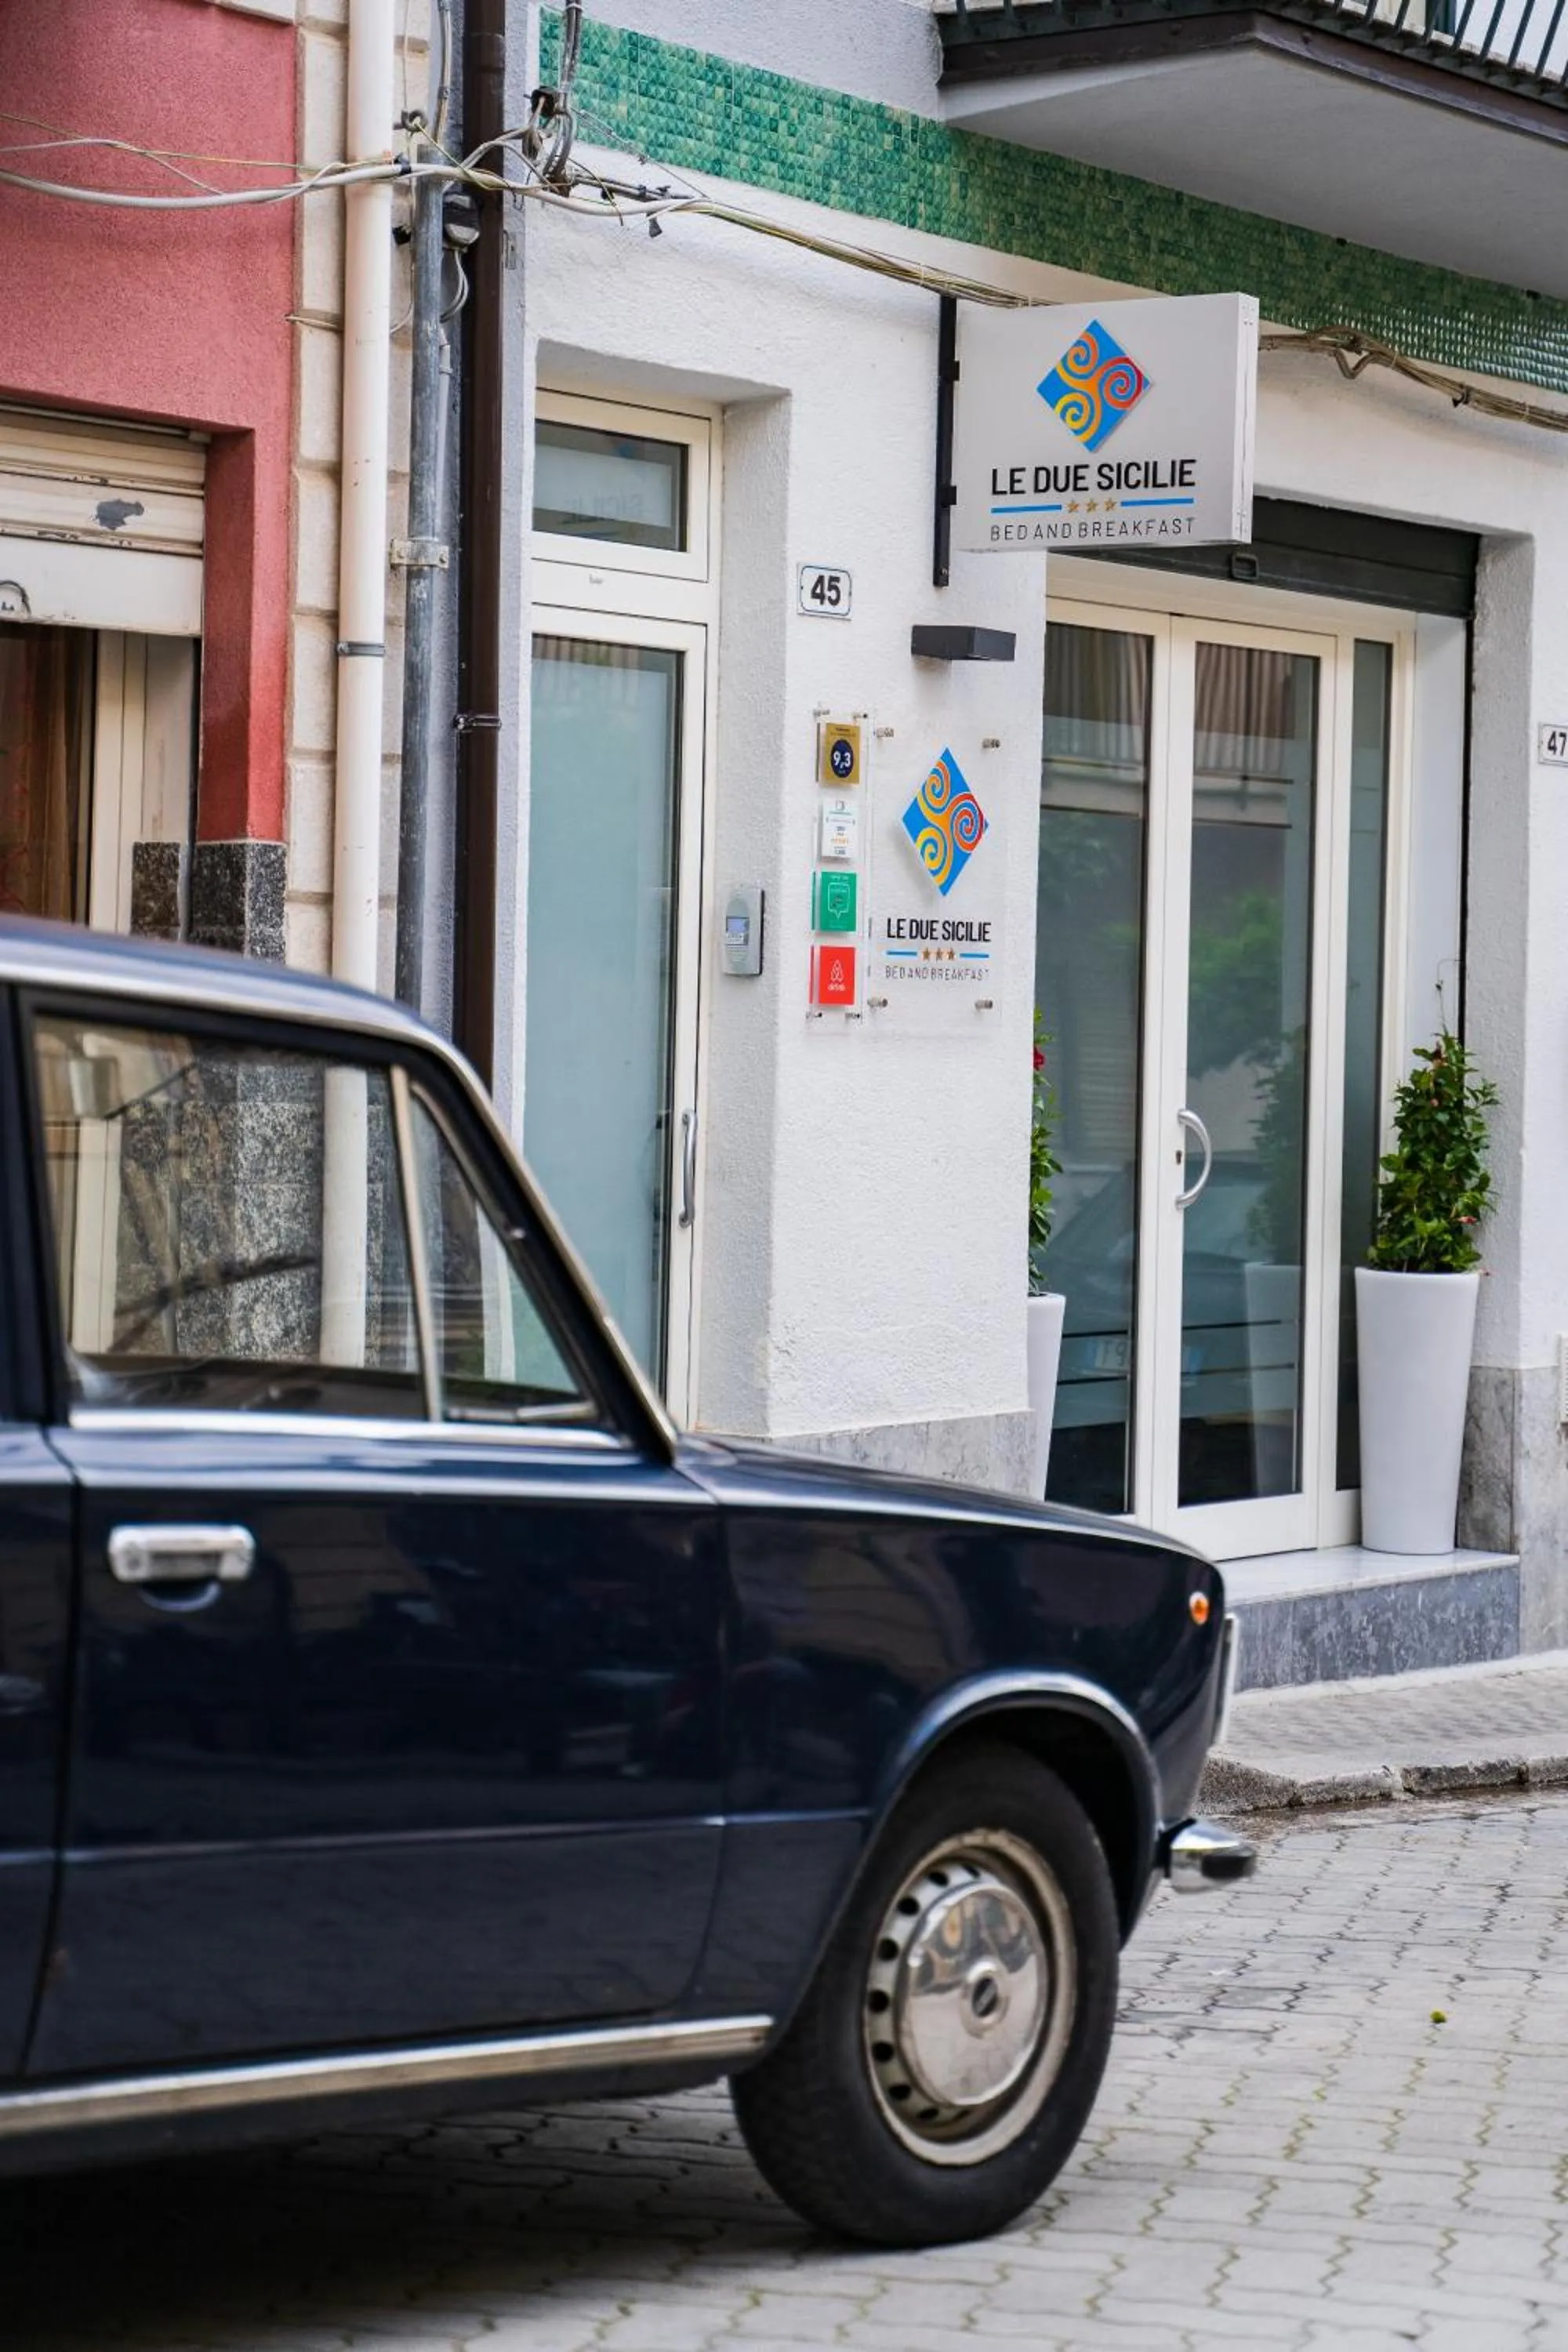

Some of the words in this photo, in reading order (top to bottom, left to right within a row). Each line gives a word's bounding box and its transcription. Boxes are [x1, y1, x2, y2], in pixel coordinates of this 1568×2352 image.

[991, 467, 1026, 496] LE
[1033, 464, 1090, 494] DUE
[1097, 459, 1196, 491] SICILIE
[990, 524, 1028, 542] BED
[1033, 522, 1072, 540] AND
[1078, 517, 1196, 539] BREAKFAST
[811, 574, 841, 607] 45
[1547, 730, 1567, 757] 47
[887, 917, 907, 939] LE
[909, 918, 939, 941] DUE
[942, 920, 992, 942] SICILIE
[885, 965, 906, 979] BED
[907, 965, 929, 980] AND
[931, 966, 990, 982] BREAKFAST
